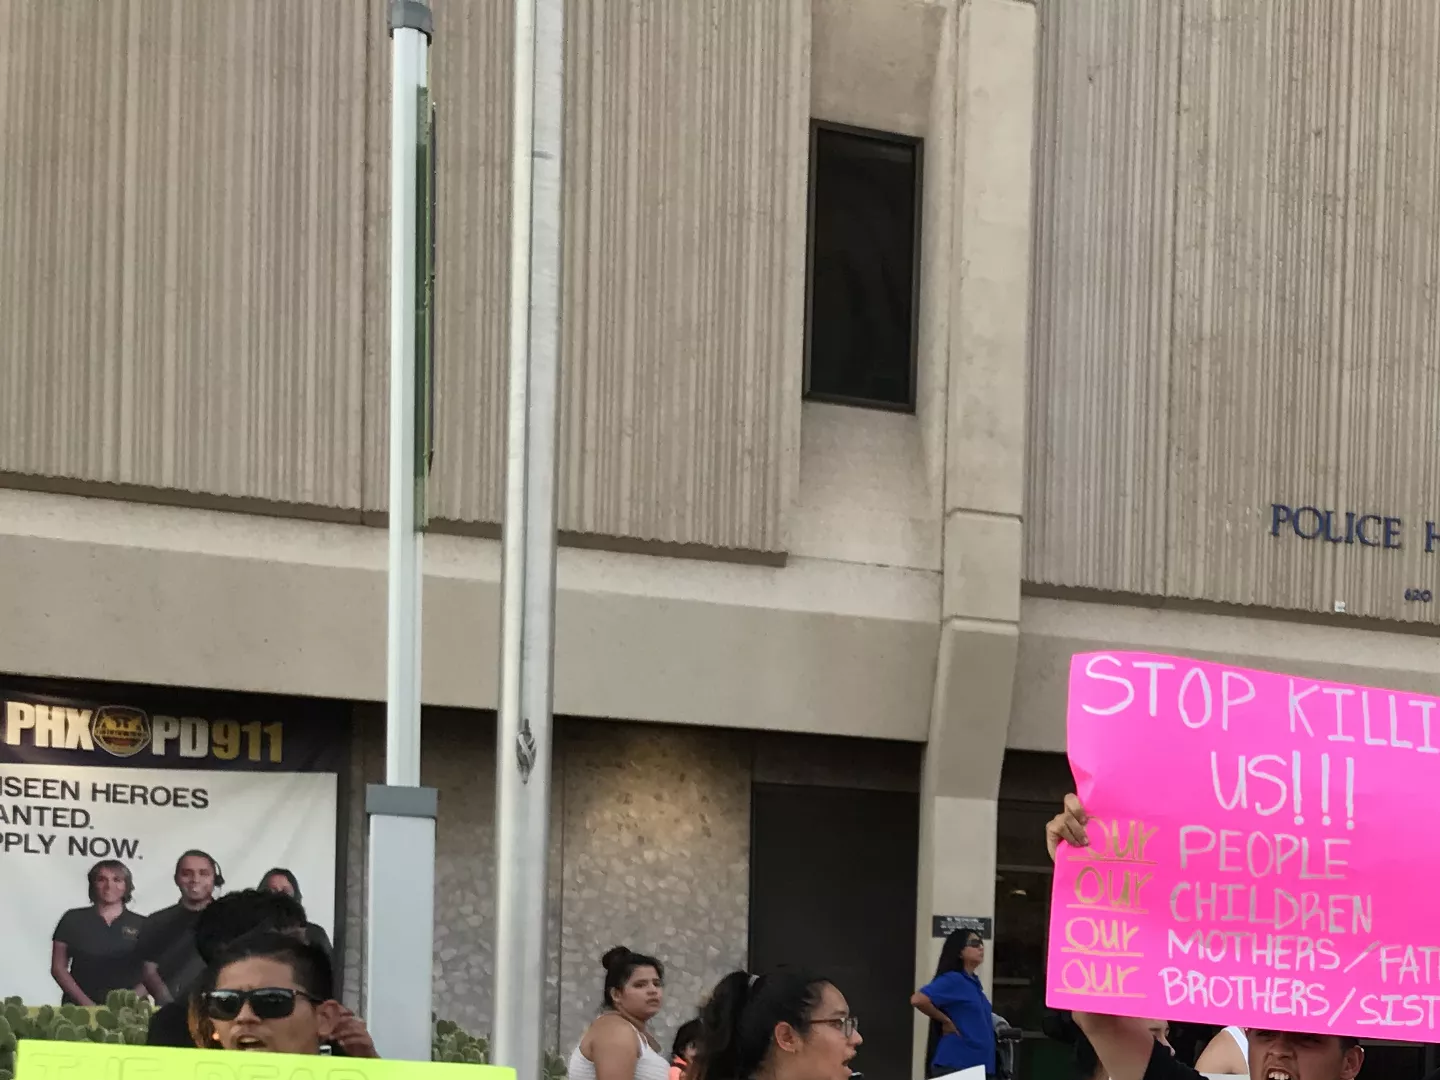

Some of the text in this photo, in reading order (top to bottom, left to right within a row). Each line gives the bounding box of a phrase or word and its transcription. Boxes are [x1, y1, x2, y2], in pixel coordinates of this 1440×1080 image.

[1270, 503, 1402, 549] POLICE
[1080, 655, 1256, 731] STOP
[7, 701, 283, 764] PHX PD911
[0, 776, 209, 809] SEEN HEROES
[1211, 749, 1355, 830] US!!!
[0, 832, 143, 860] PLY NOW.
[1179, 824, 1352, 879] PEOPLE
[1170, 881, 1372, 934] CHILDREN
